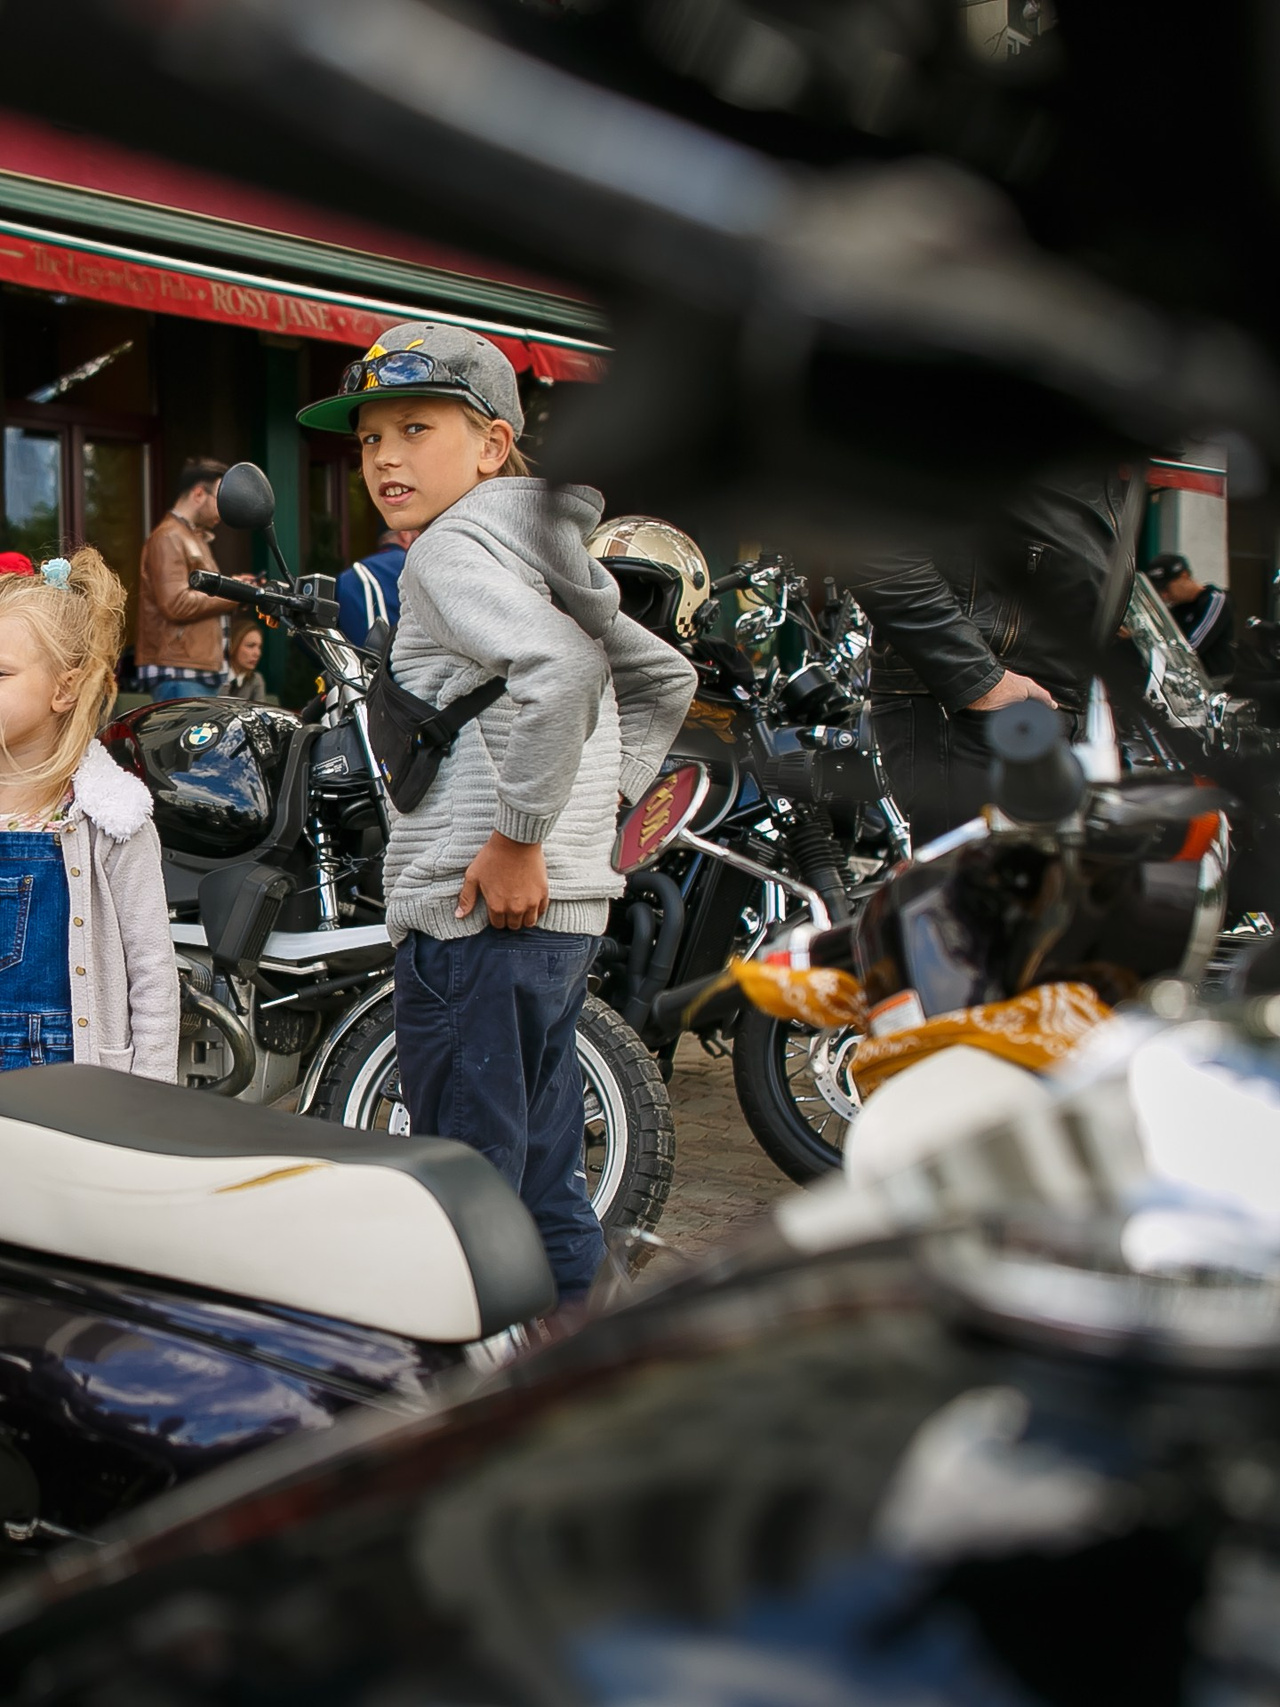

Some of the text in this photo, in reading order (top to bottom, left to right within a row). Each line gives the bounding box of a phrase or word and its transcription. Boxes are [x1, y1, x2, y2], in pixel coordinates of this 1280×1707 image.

[32, 246, 63, 276] The
[210, 282, 272, 320] ROSY
[275, 297, 333, 332] JANE
